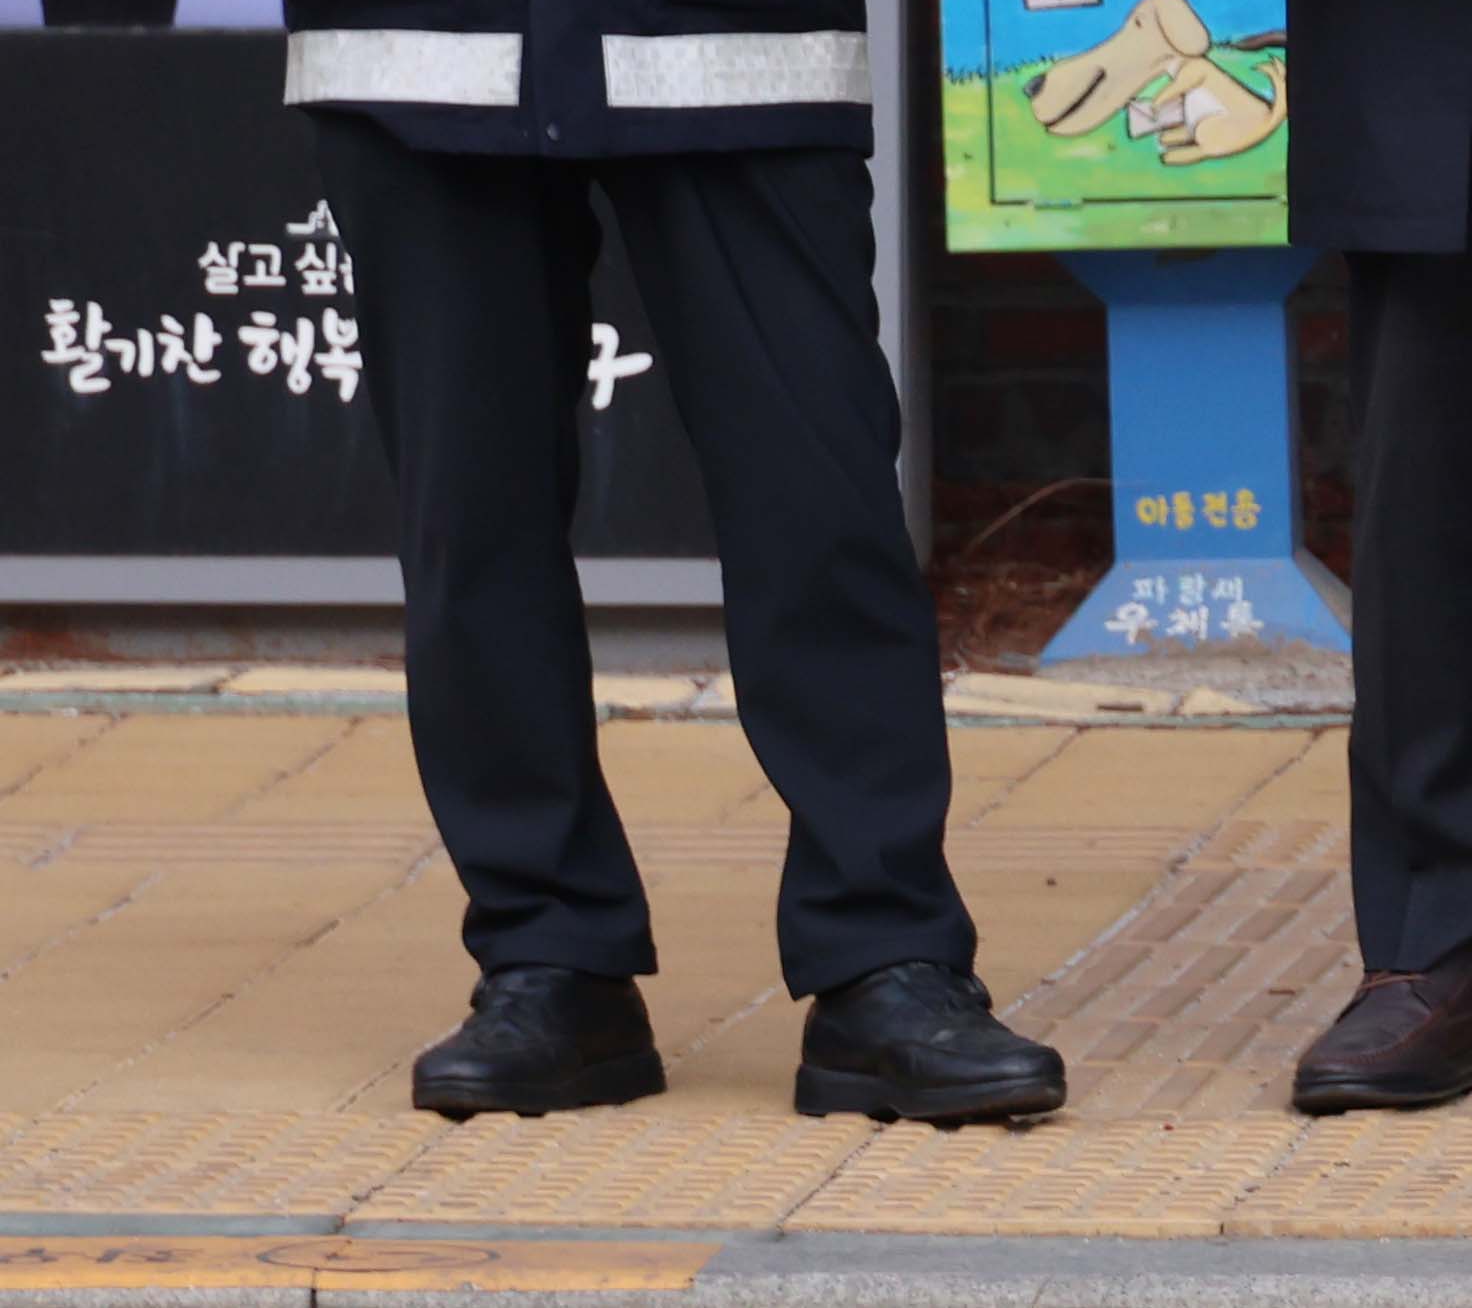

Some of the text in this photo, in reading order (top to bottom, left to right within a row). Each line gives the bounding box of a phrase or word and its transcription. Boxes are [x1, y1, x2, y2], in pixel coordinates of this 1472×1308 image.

[199, 240, 355, 295] 살고 싶
[41, 299, 222, 393] 활기찬
